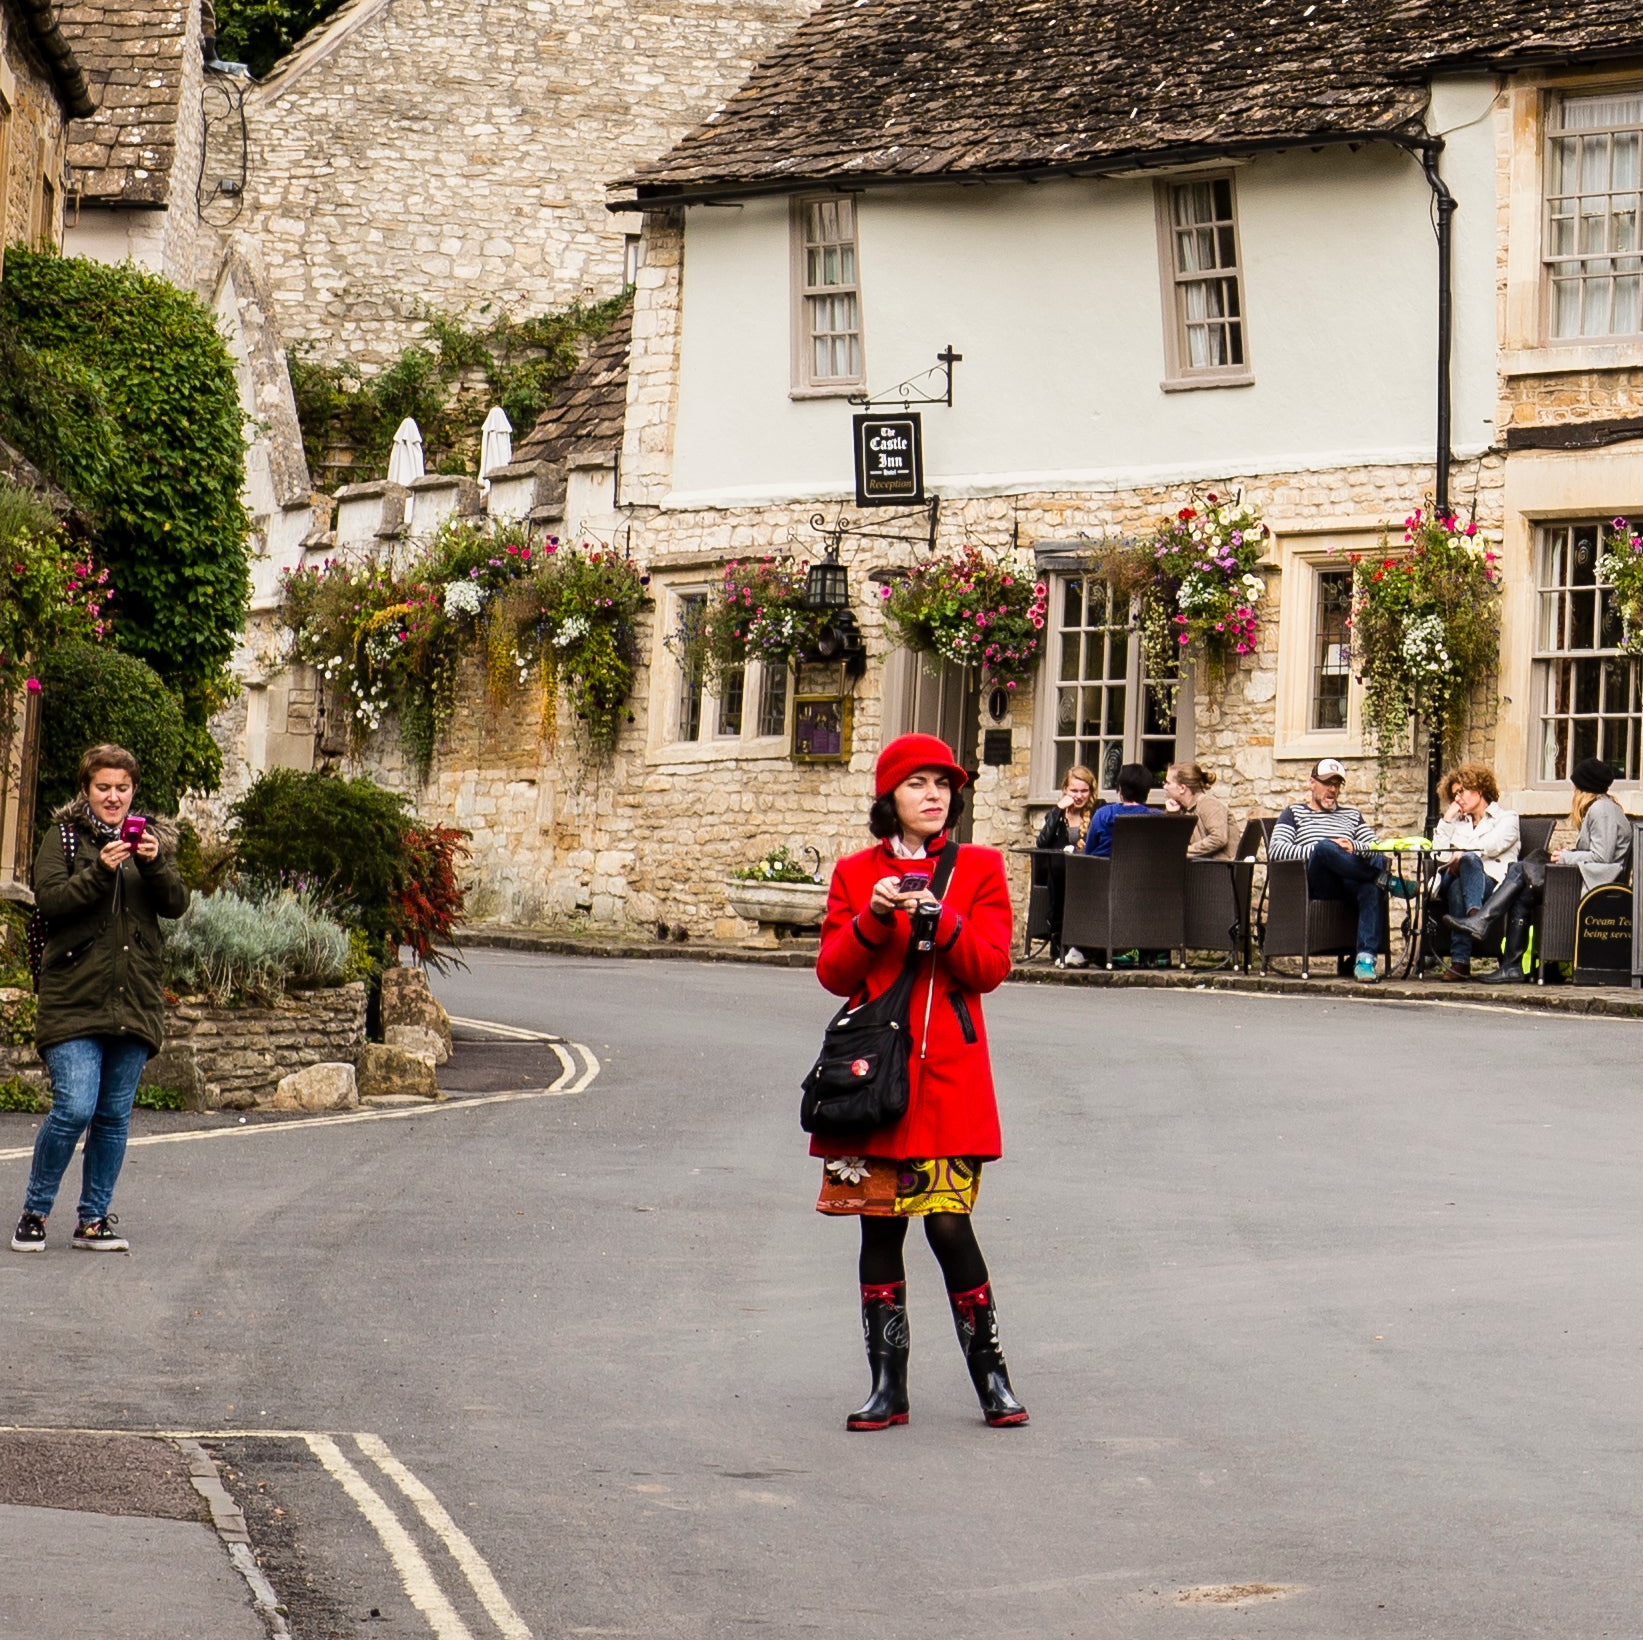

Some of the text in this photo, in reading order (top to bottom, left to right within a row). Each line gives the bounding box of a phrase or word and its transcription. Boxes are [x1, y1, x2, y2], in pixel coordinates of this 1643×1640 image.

[880, 427, 896, 437] The
[870, 436, 908, 451] Castle
[878, 453, 903, 468] Inn
[870, 479, 912, 491] Reception
[1585, 915, 1616, 926] Cream
[1583, 928, 1609, 940] being
